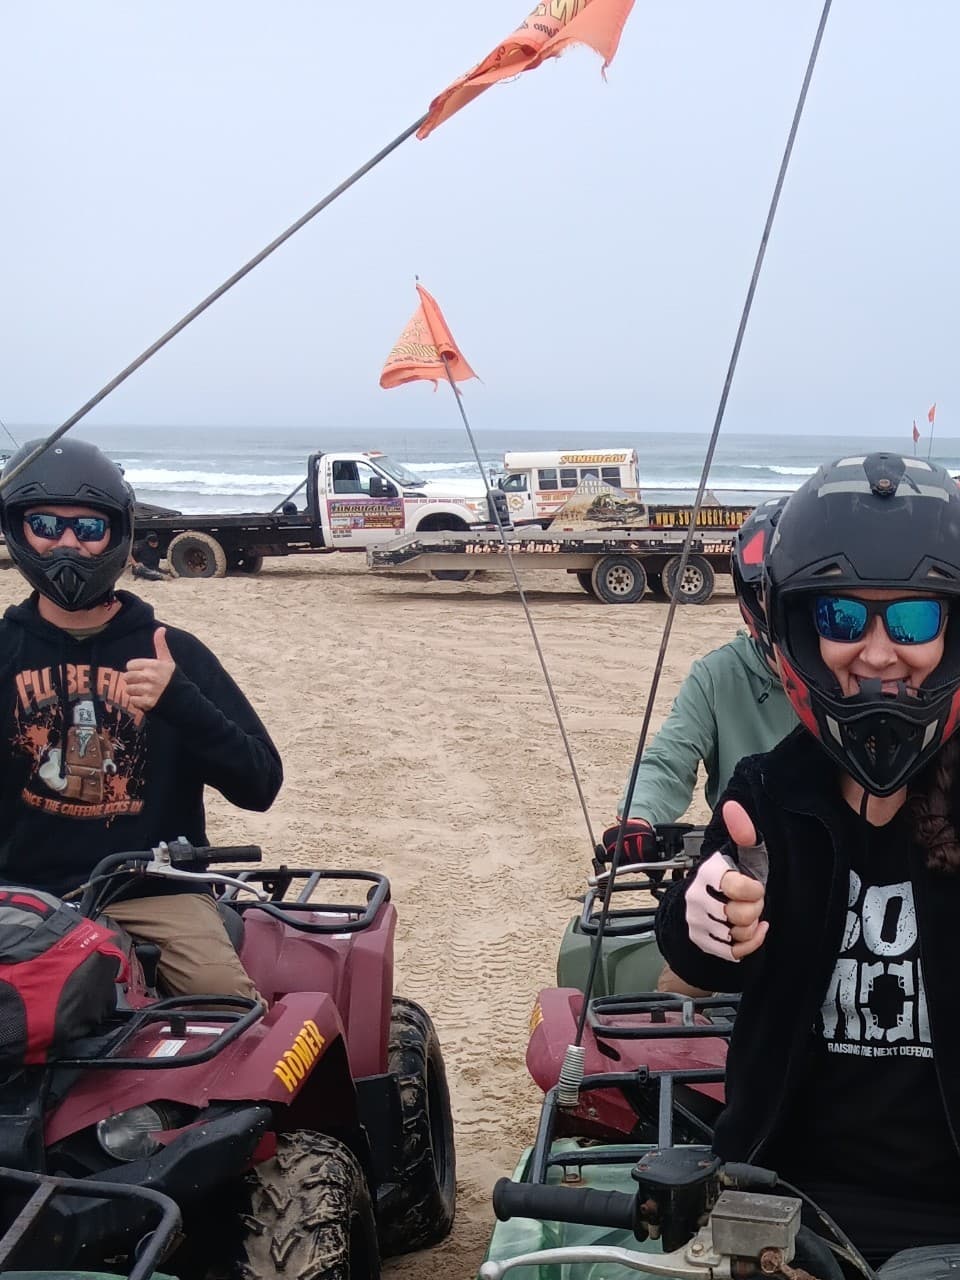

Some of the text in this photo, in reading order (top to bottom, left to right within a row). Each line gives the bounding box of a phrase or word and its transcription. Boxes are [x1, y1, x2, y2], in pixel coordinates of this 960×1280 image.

[44, 798, 61, 812] THE
[61, 803, 104, 816] CAFFEINE
[104, 801, 129, 814] KICKS
[130, 800, 143, 812] IN
[272, 1019, 326, 1093] HOMER
[873, 1046, 898, 1057] NEXT
